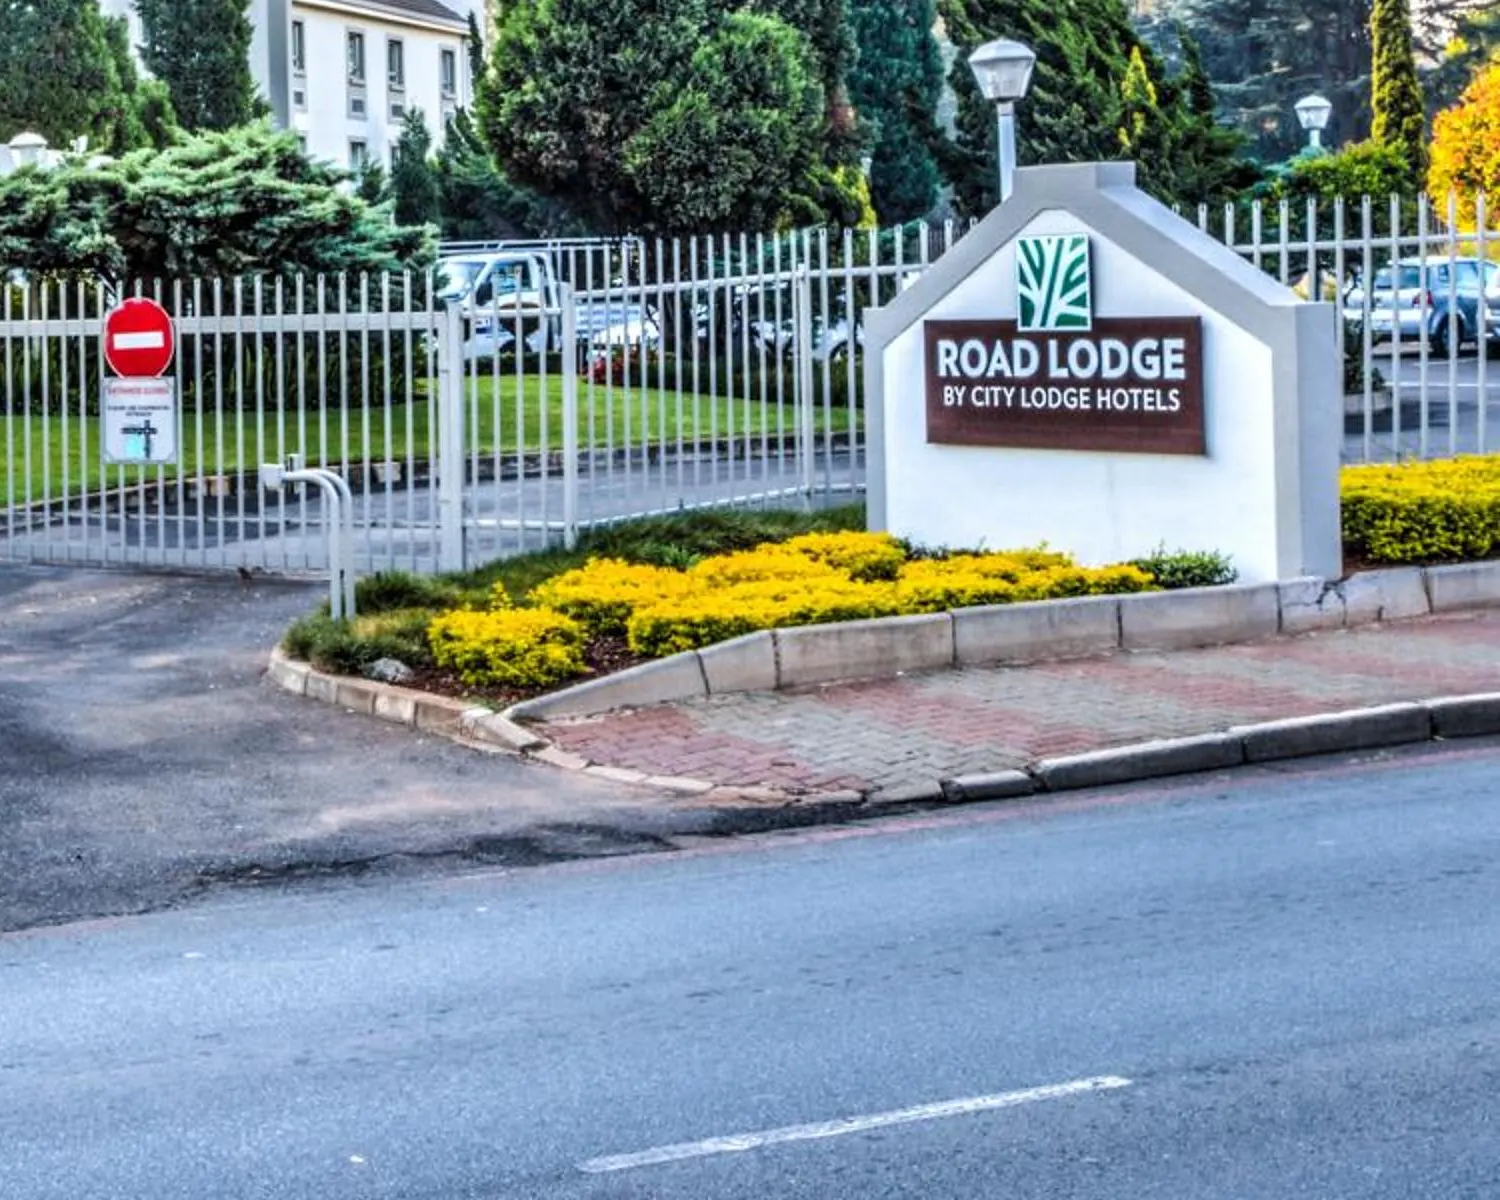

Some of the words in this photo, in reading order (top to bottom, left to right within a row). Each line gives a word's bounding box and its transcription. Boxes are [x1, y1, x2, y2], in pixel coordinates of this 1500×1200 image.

[936, 339, 1040, 378] ROAD
[1048, 339, 1186, 380] LODGE
[943, 386, 966, 406] BY
[971, 387, 1015, 408] CITY
[1020, 388, 1090, 408] LODGE
[1097, 389, 1181, 412] HOTELS
